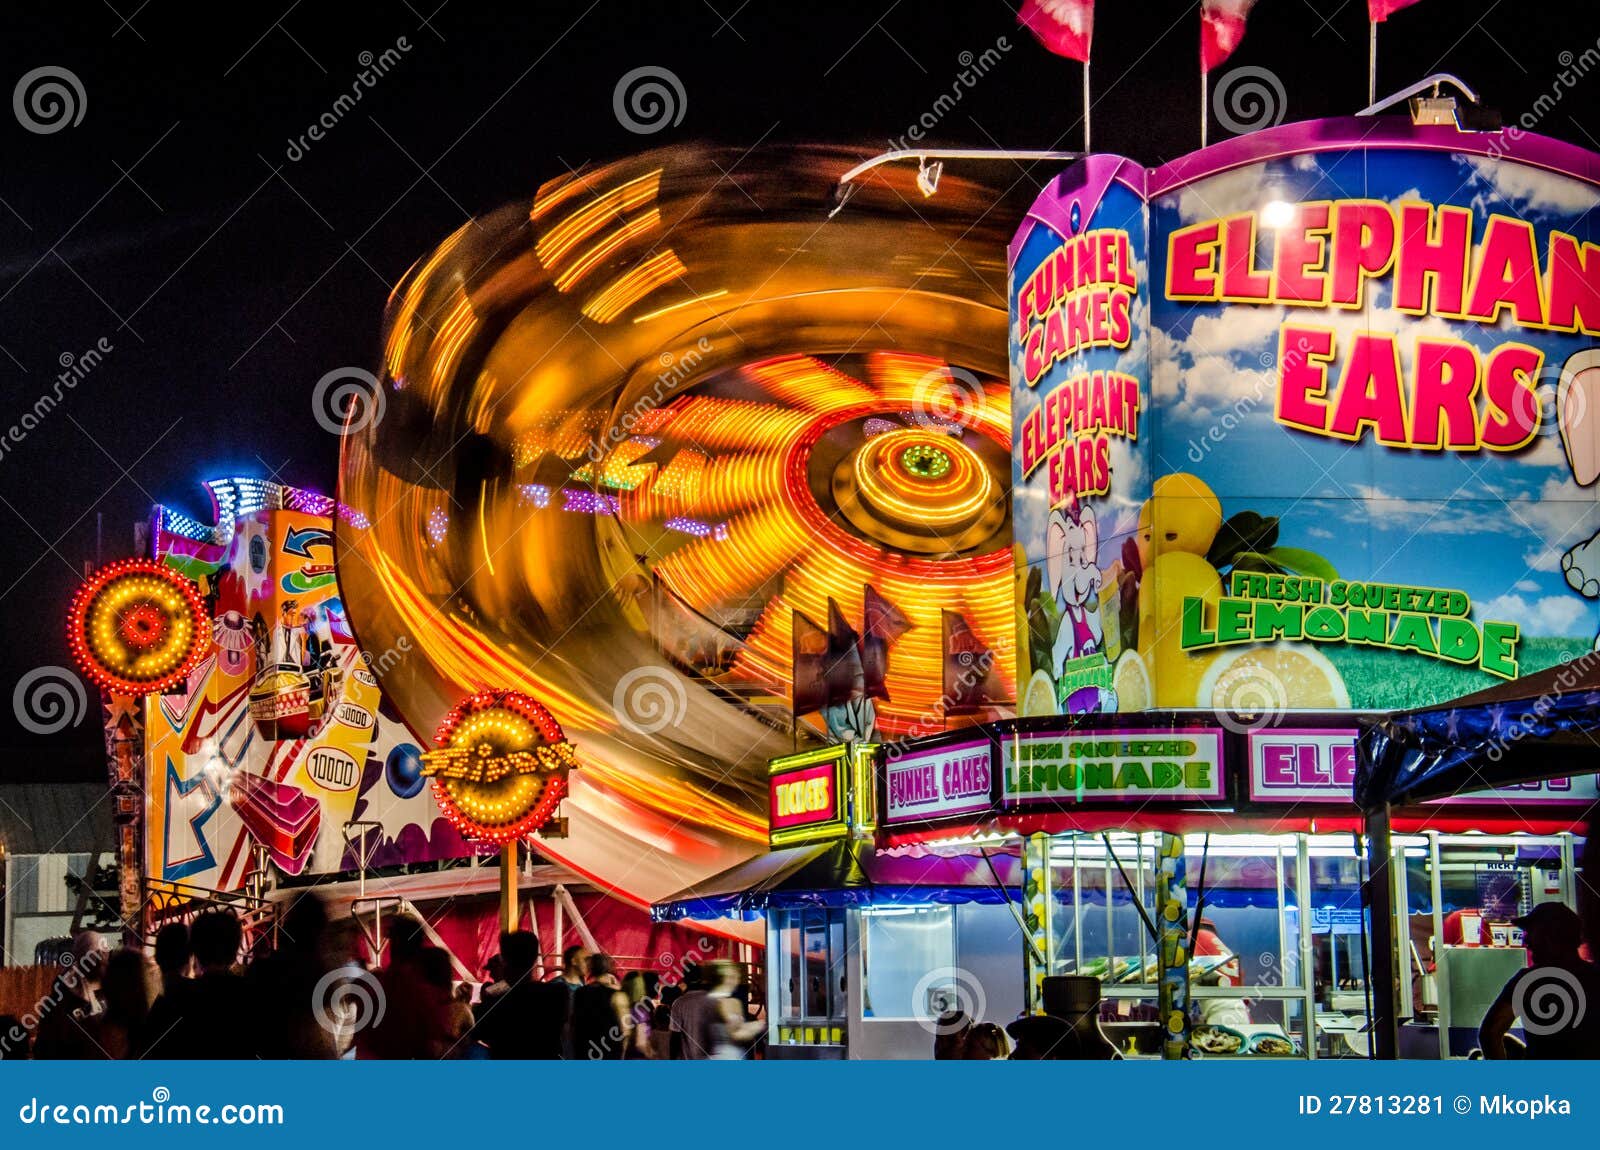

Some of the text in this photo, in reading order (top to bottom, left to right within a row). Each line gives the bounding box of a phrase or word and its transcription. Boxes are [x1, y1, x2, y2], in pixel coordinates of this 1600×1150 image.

[1018, 228, 1137, 345] FUNNEL
[1165, 198, 1600, 335] ELEPHAN
[1024, 287, 1131, 388] CAKES
[1275, 321, 1545, 452] EARS
[1021, 370, 1140, 480] ELEPHANT
[1048, 434, 1110, 505] EARS
[1232, 570, 1472, 618] FRESH SQUEEZED
[1181, 595, 1520, 680] LEMONADE
[340, 704, 367, 727] 50000
[313, 752, 354, 787] 10000
[1006, 762, 1211, 793] LEMONADE
[1069, 740, 1197, 758] SQUEEZED
[776, 776, 829, 817] TICKETS
[888, 753, 992, 809] FUNNEL CAKES
